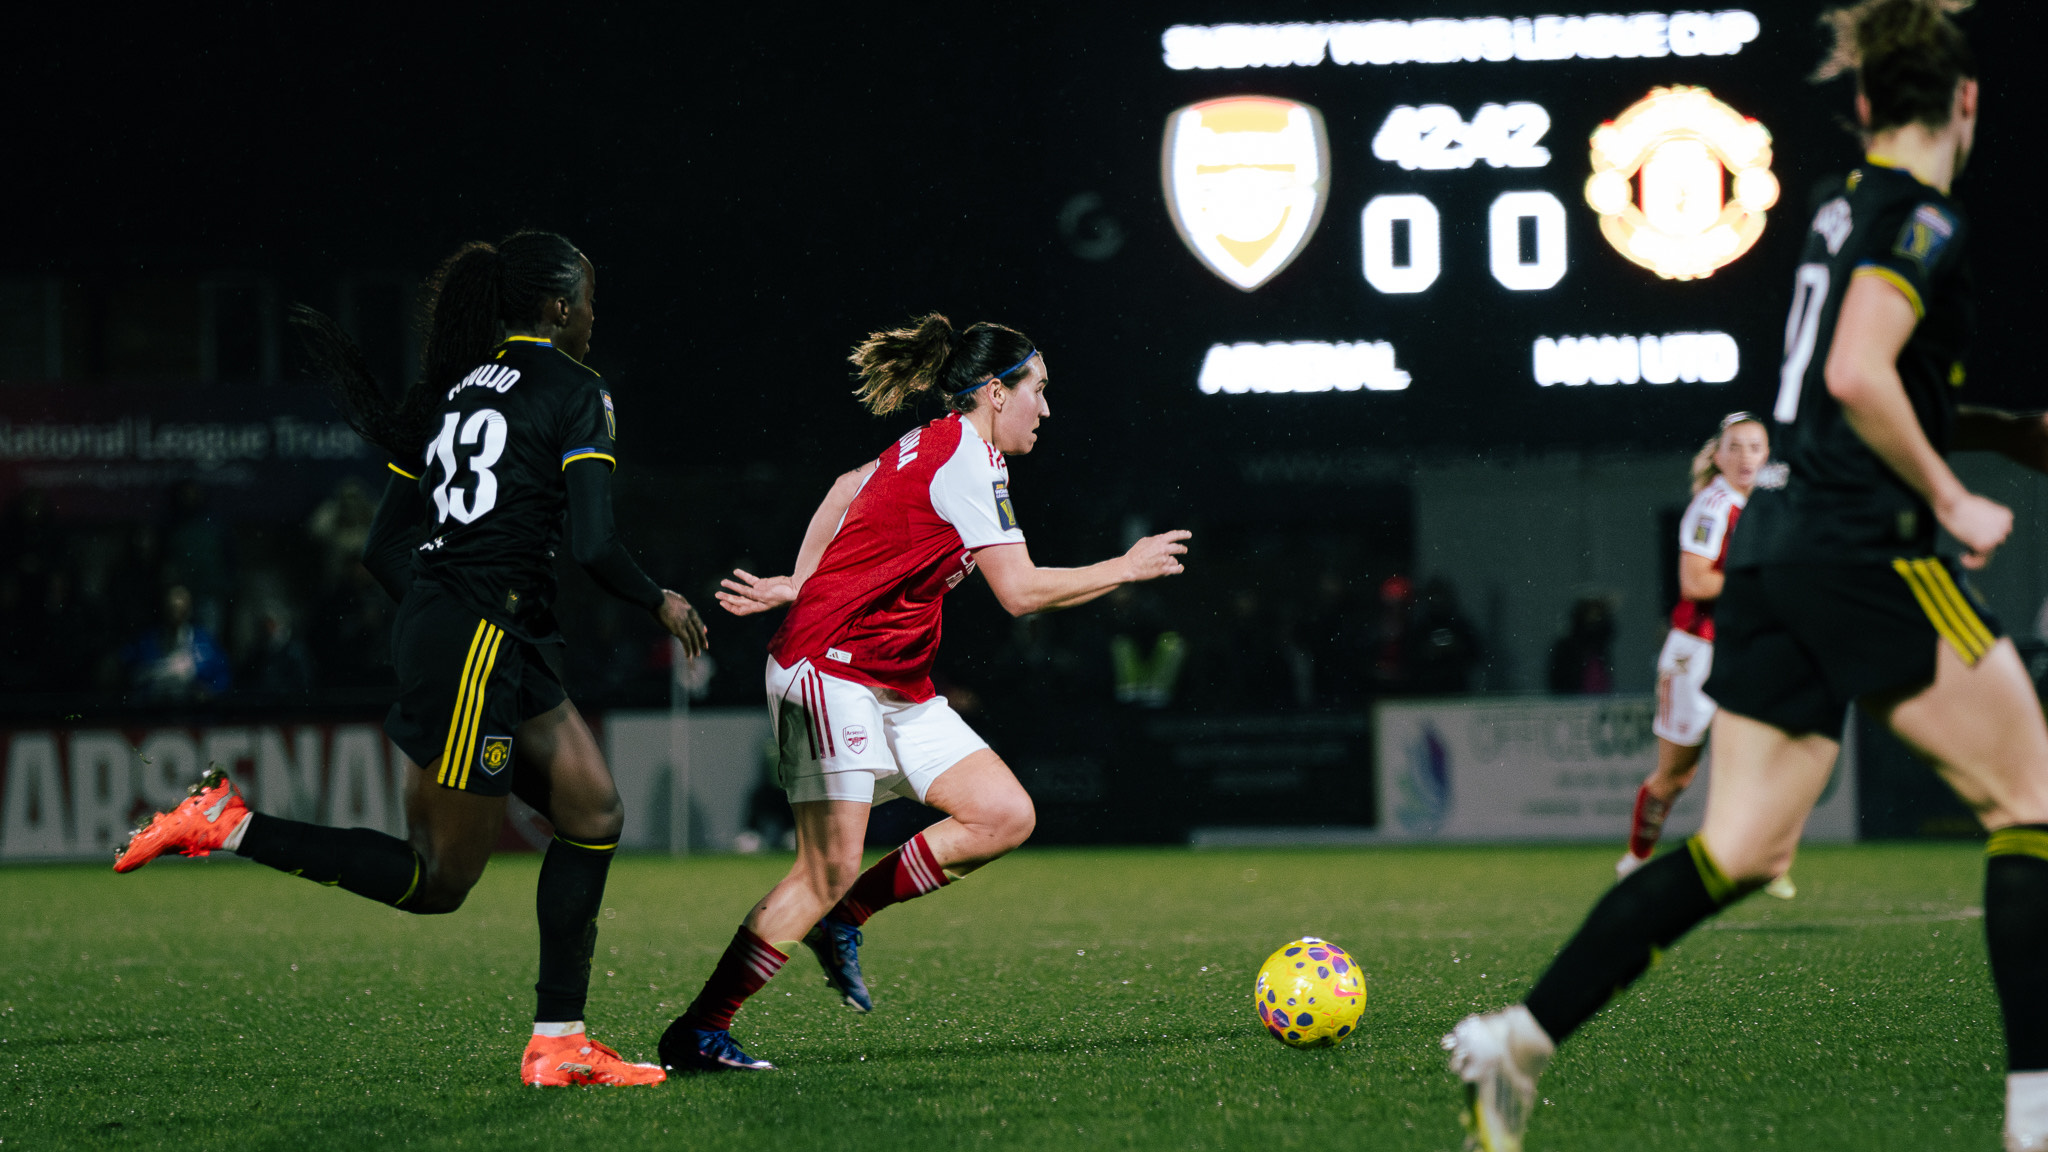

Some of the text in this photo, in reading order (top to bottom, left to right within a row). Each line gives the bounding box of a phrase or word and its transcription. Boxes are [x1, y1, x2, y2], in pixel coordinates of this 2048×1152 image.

[1361, 190, 1568, 293] 0 0
[426, 408, 508, 525] 13
[3, 728, 408, 858] ARSENA
